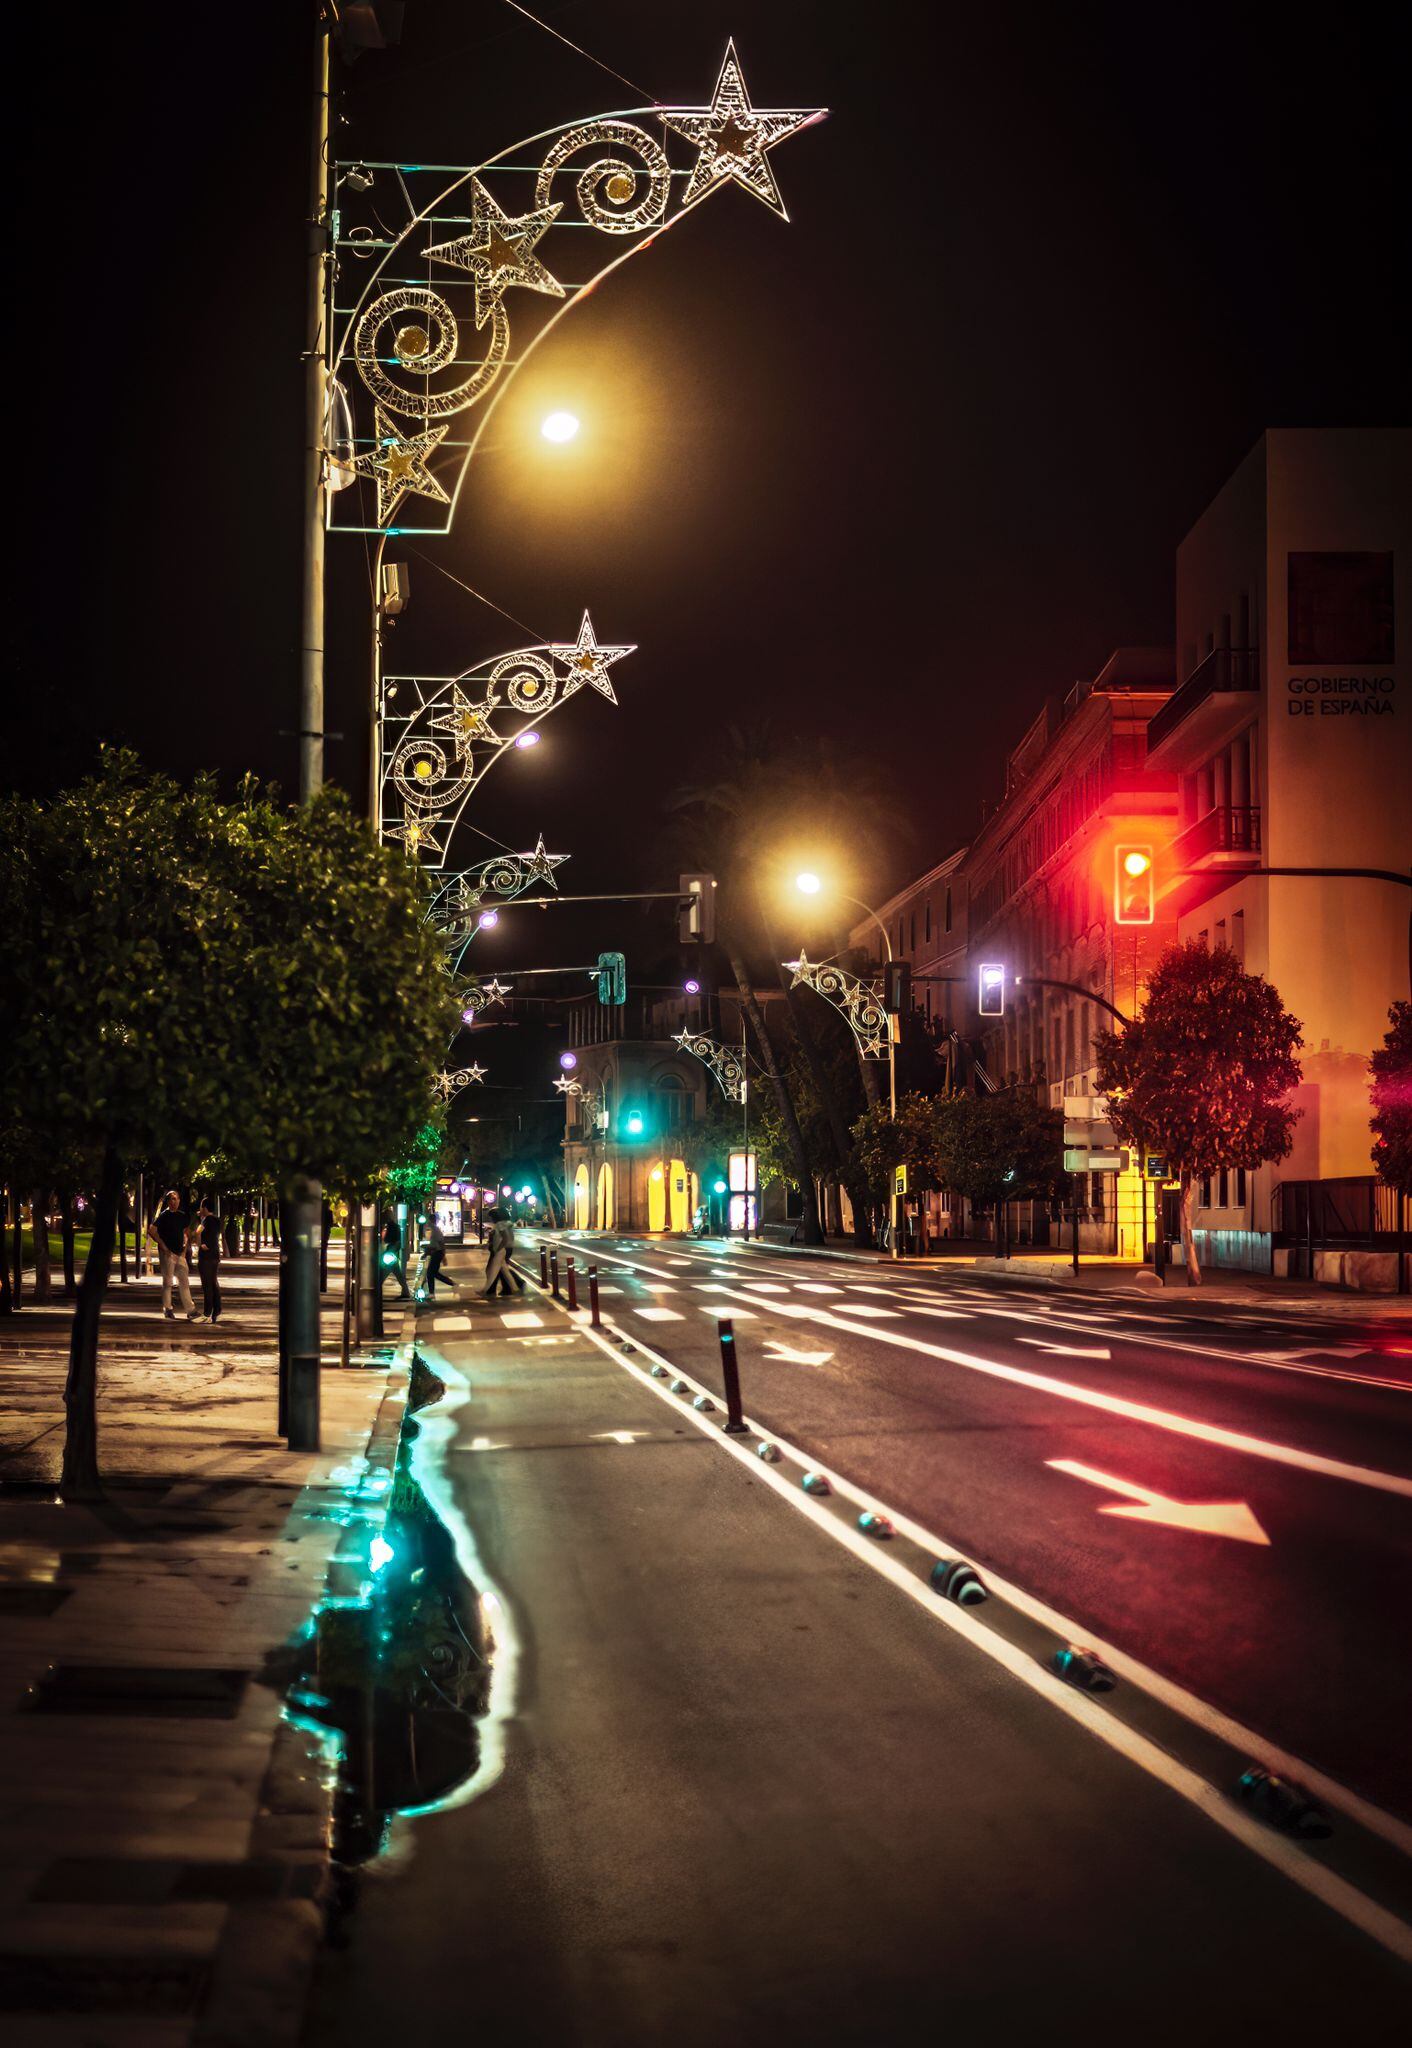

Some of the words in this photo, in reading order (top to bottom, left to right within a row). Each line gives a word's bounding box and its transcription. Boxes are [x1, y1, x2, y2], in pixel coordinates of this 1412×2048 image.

[1288, 677, 1395, 694] GOBIERNO
[1288, 699, 1314, 715] DE
[1321, 696, 1394, 715] ESPAÑA
